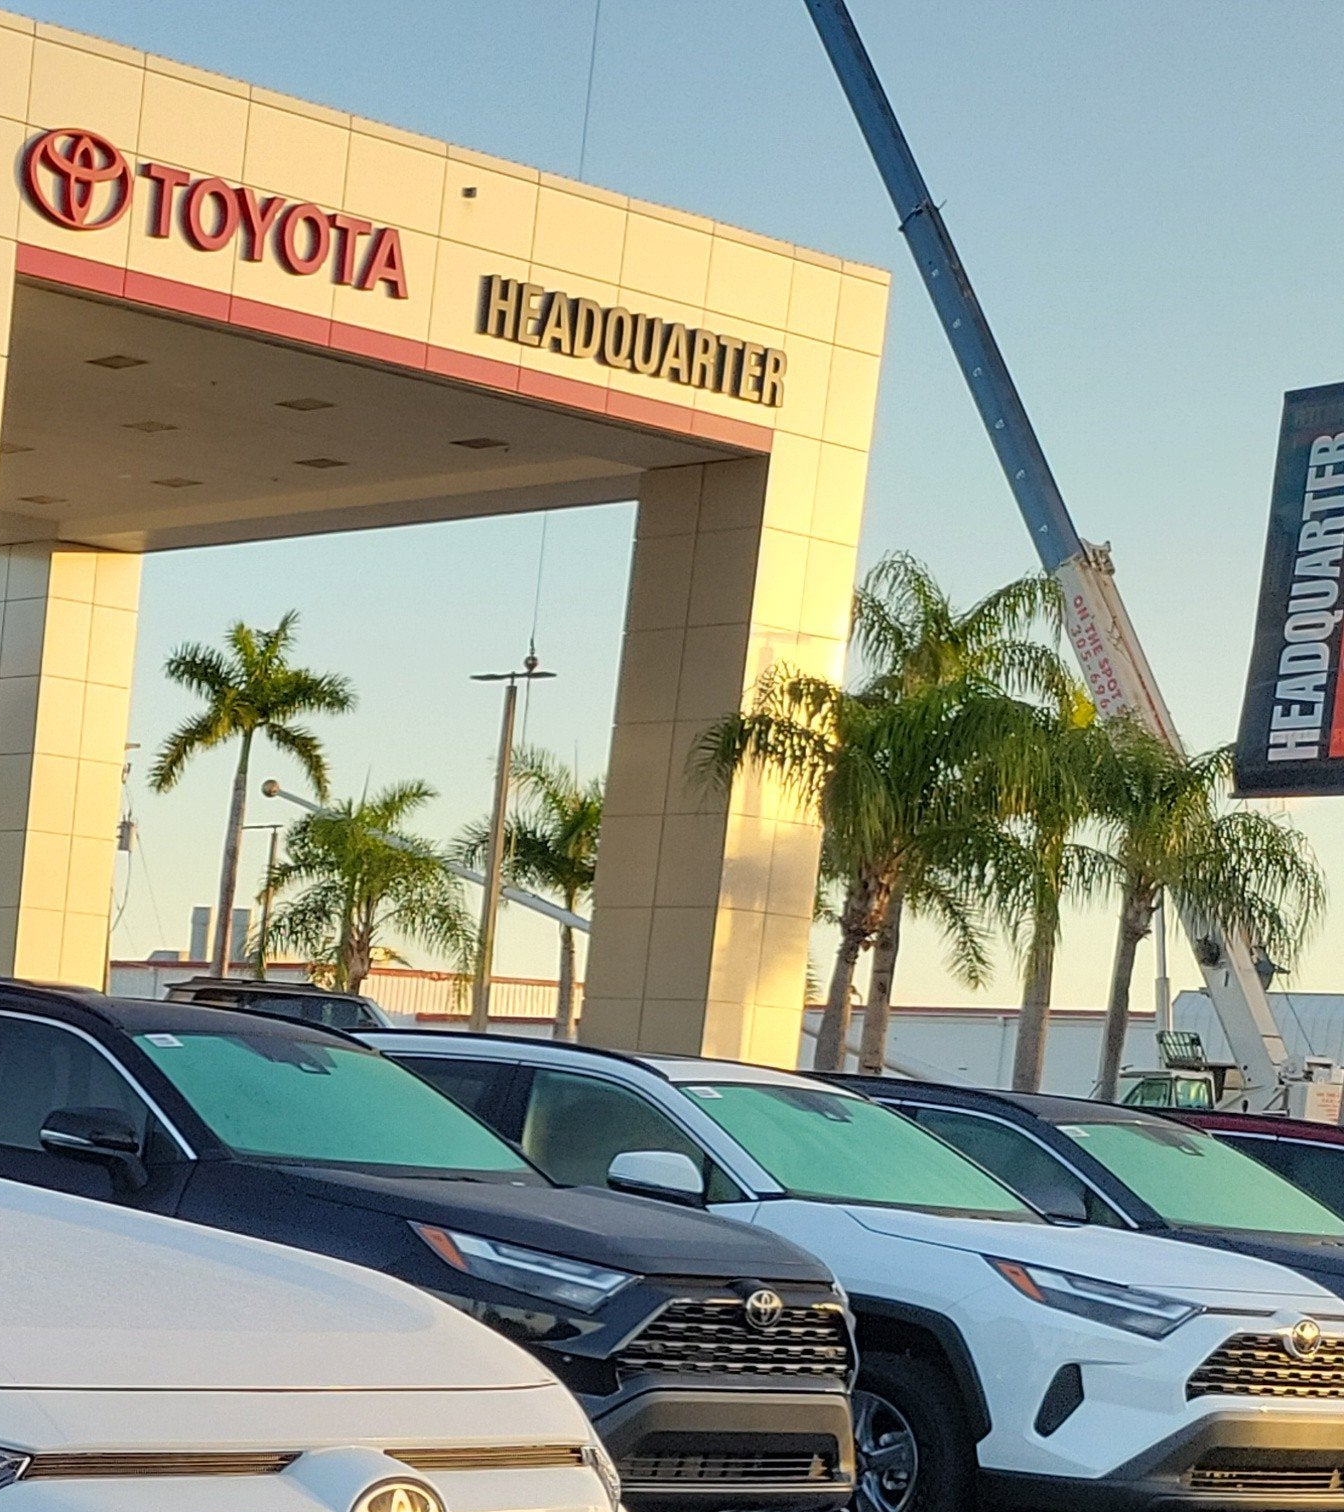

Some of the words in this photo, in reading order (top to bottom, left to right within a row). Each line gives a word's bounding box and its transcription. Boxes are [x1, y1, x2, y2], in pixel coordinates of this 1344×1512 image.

[138, 162, 409, 300] TOYOTA
[476, 274, 788, 408] HEADQUARTER
[1073, 595, 1090, 621] ON
[1085, 623, 1103, 656] THE
[1099, 657, 1123, 699] SPOT
[1267, 432, 1344, 762] HEADQUARTER
